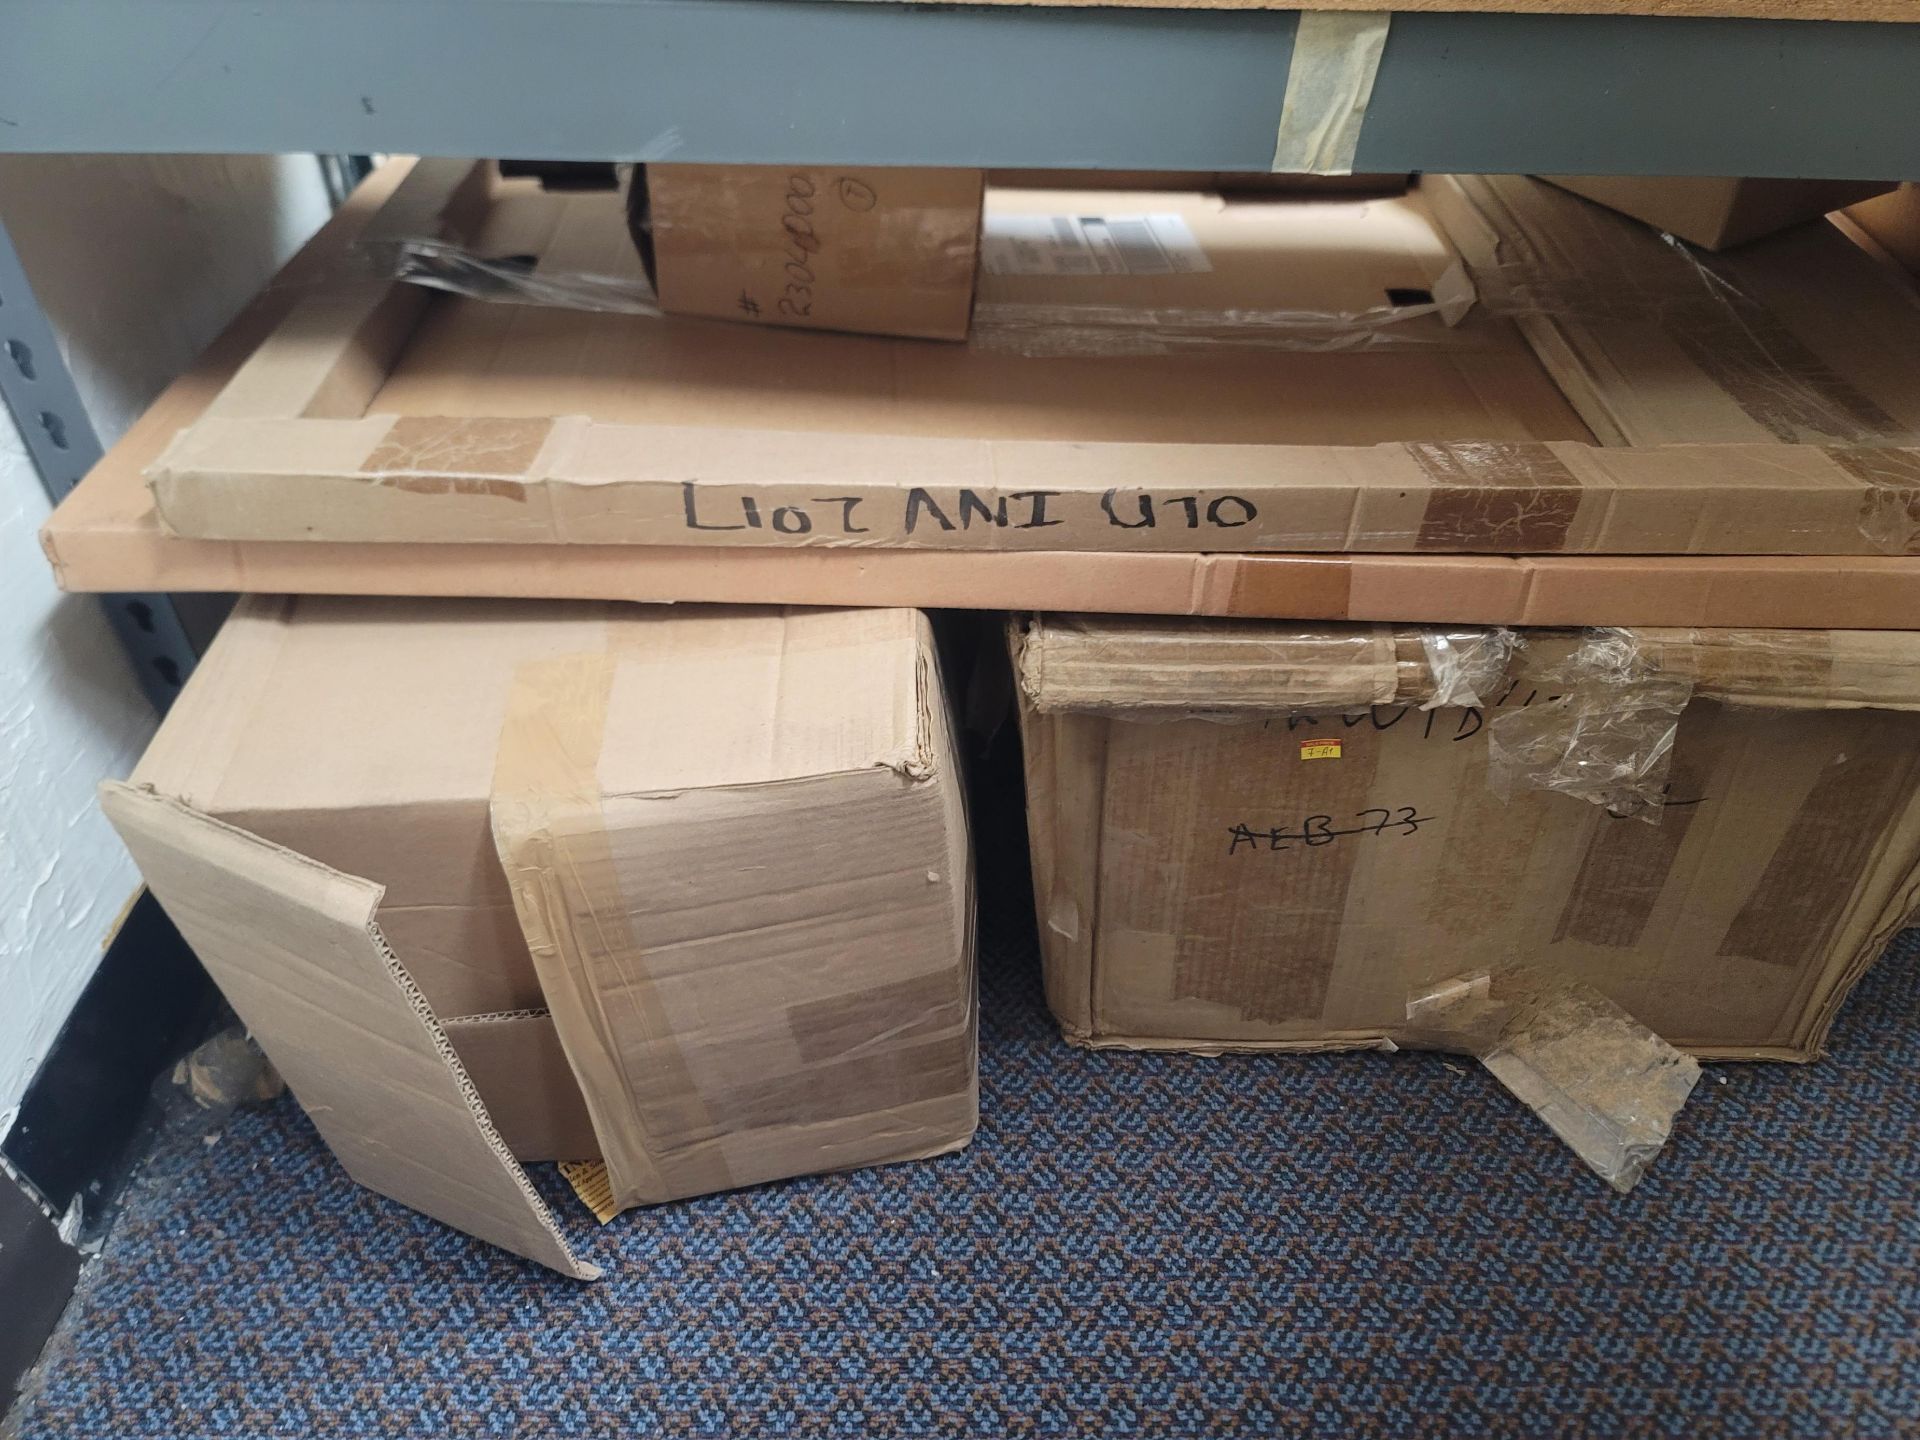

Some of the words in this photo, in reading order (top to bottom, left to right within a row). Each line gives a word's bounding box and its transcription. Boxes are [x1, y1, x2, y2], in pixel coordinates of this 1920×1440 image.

[737, 288, 762, 318] #
[681, 479, 868, 534] 2017
[904, 486, 1065, 535] INV
